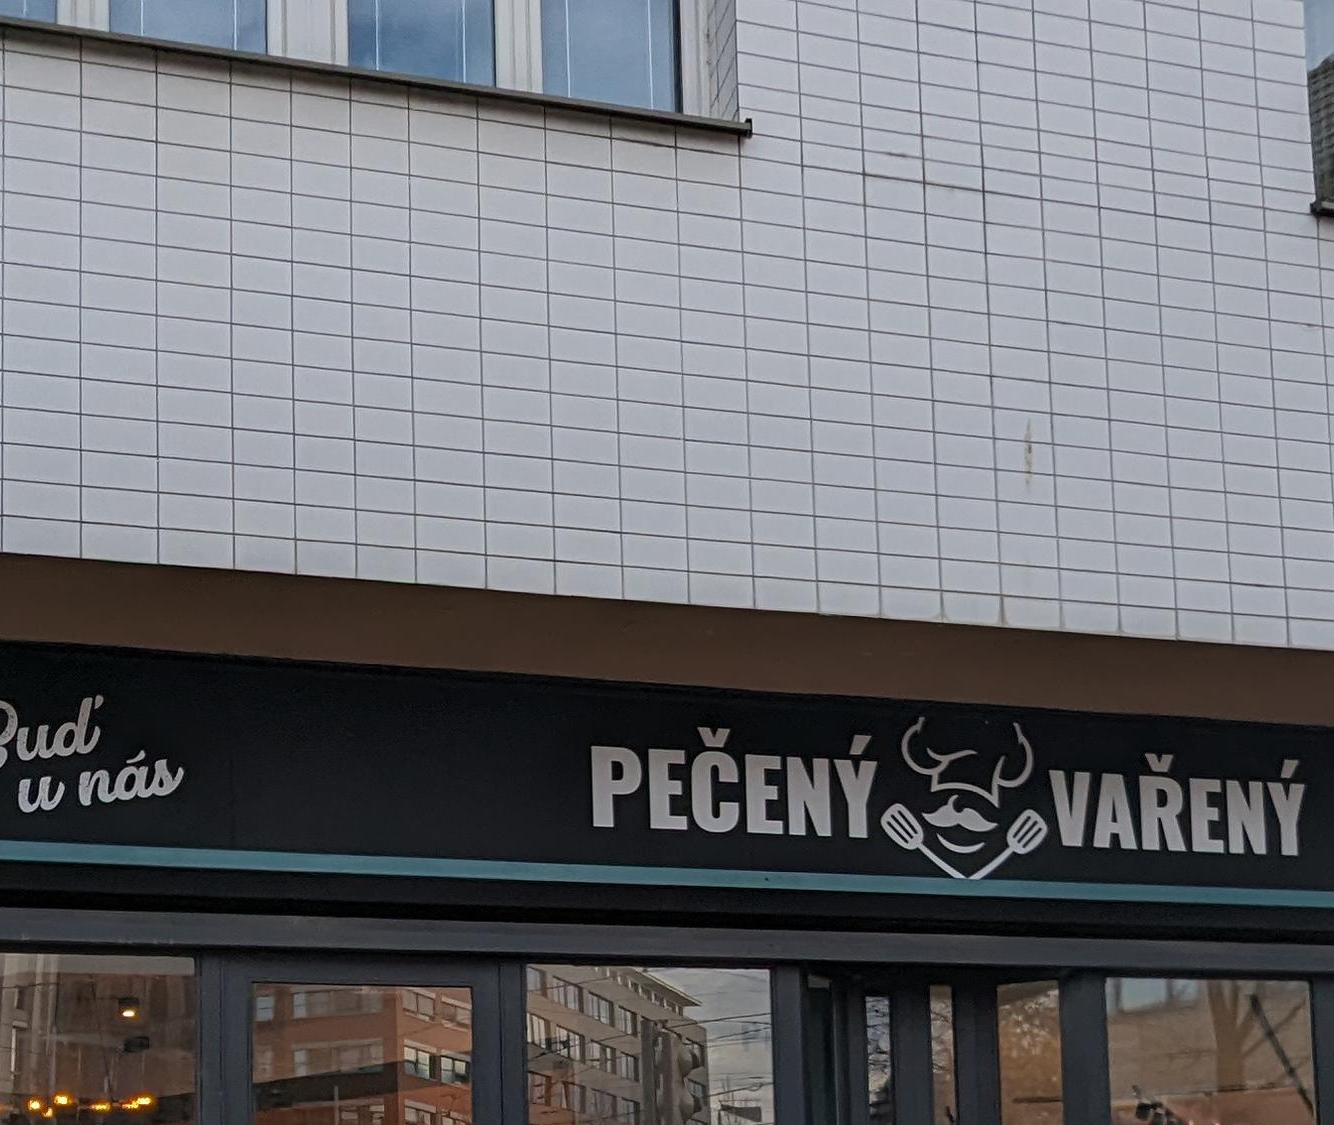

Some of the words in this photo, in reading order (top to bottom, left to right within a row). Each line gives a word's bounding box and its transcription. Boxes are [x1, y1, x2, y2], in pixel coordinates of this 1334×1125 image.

[18, 770, 65, 814] u
[78, 749, 185, 807] nás
[590, 726, 877, 839] PEČENÝ
[1049, 752, 1306, 857] VAŘENÝ
